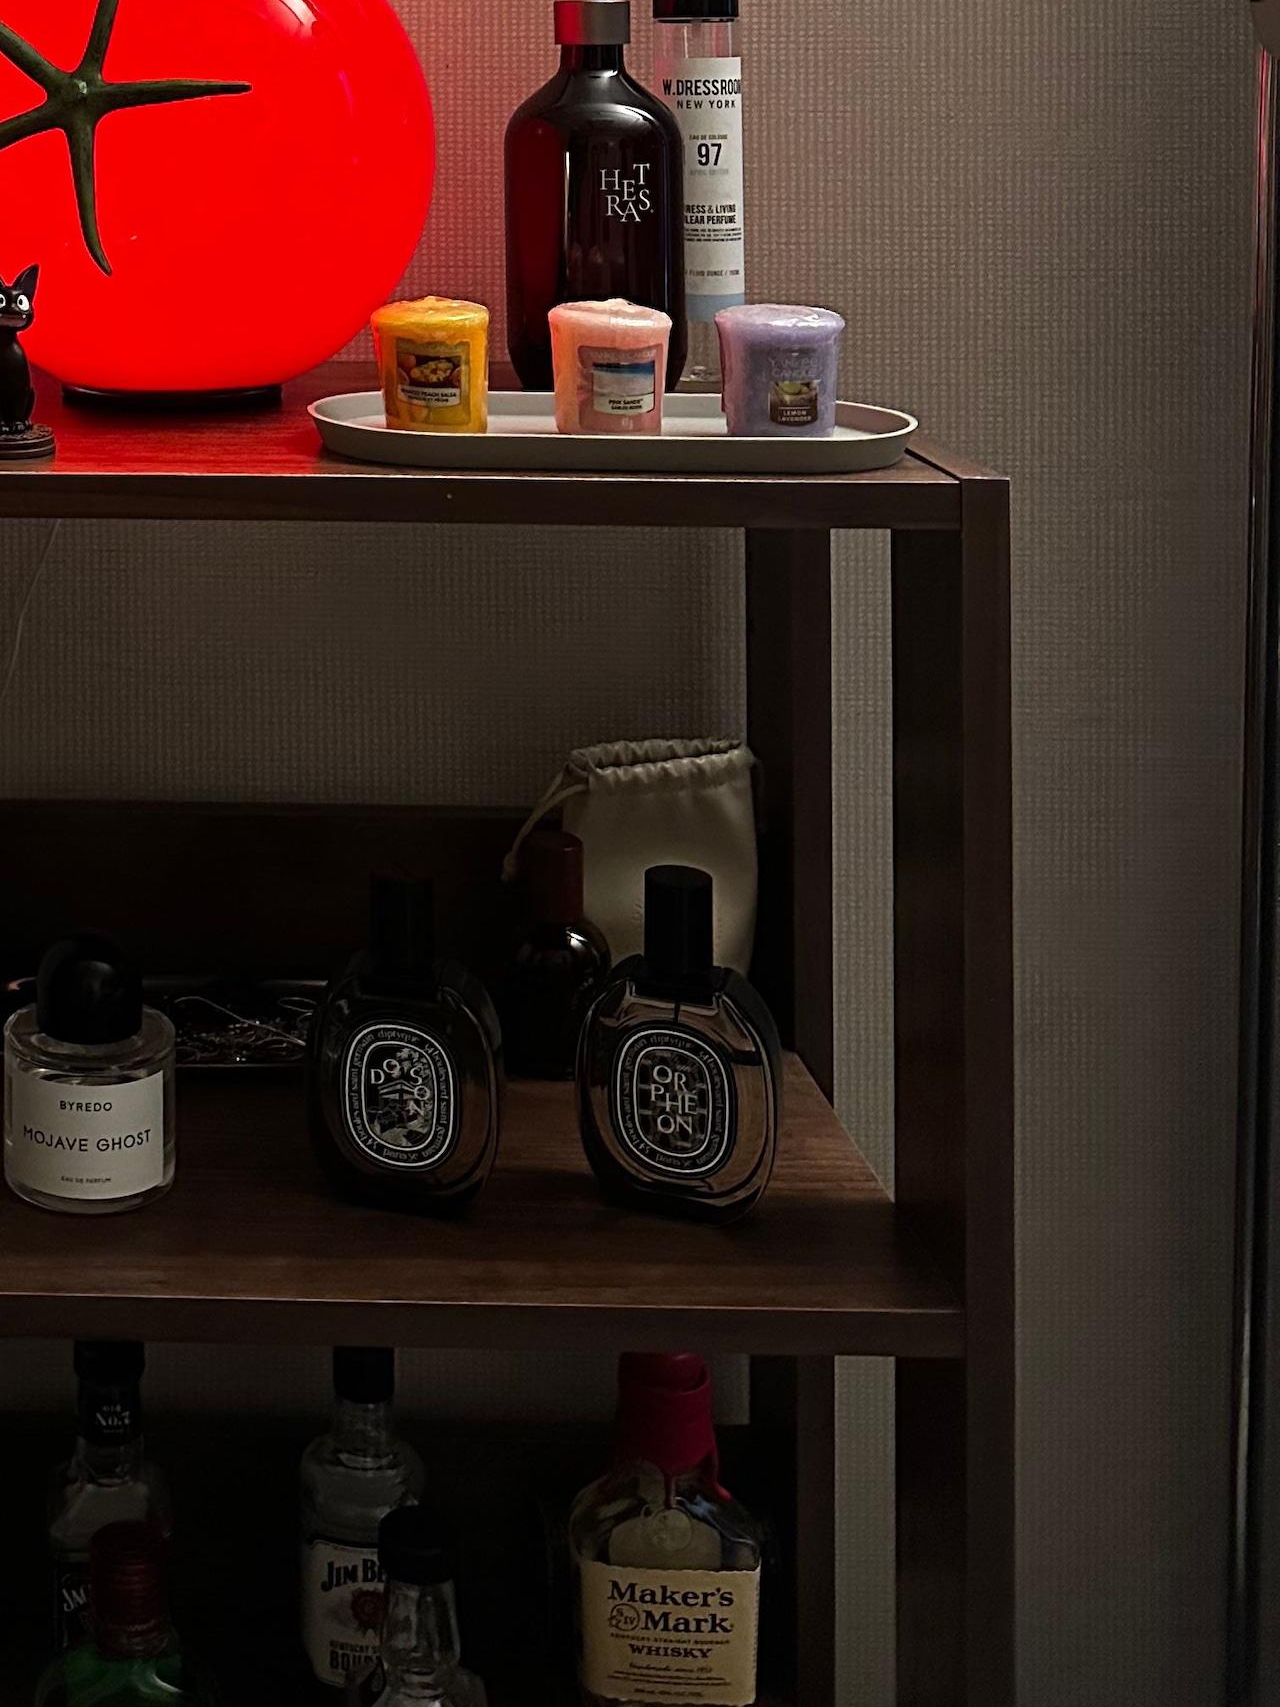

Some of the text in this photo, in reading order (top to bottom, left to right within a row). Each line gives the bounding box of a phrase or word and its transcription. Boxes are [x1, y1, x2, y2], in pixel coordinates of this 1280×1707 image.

[677, 100, 735, 109] NEW YORK
[698, 143, 721, 166] 97
[685, 205, 705, 213] RESS
[708, 205, 713, 213] &
[685, 214, 736, 224] LEAR PERFUME
[60, 1101, 112, 1112] BYREDO
[657, 1114, 692, 1135] ON
[24, 1124, 151, 1152] MOJAVE GHOST
[321, 1558, 386, 1592] JIM BE
[608, 1580, 734, 1607] Maker's
[641, 1610, 732, 1633] Mark
[628, 1644, 712, 1658] WHISKY
